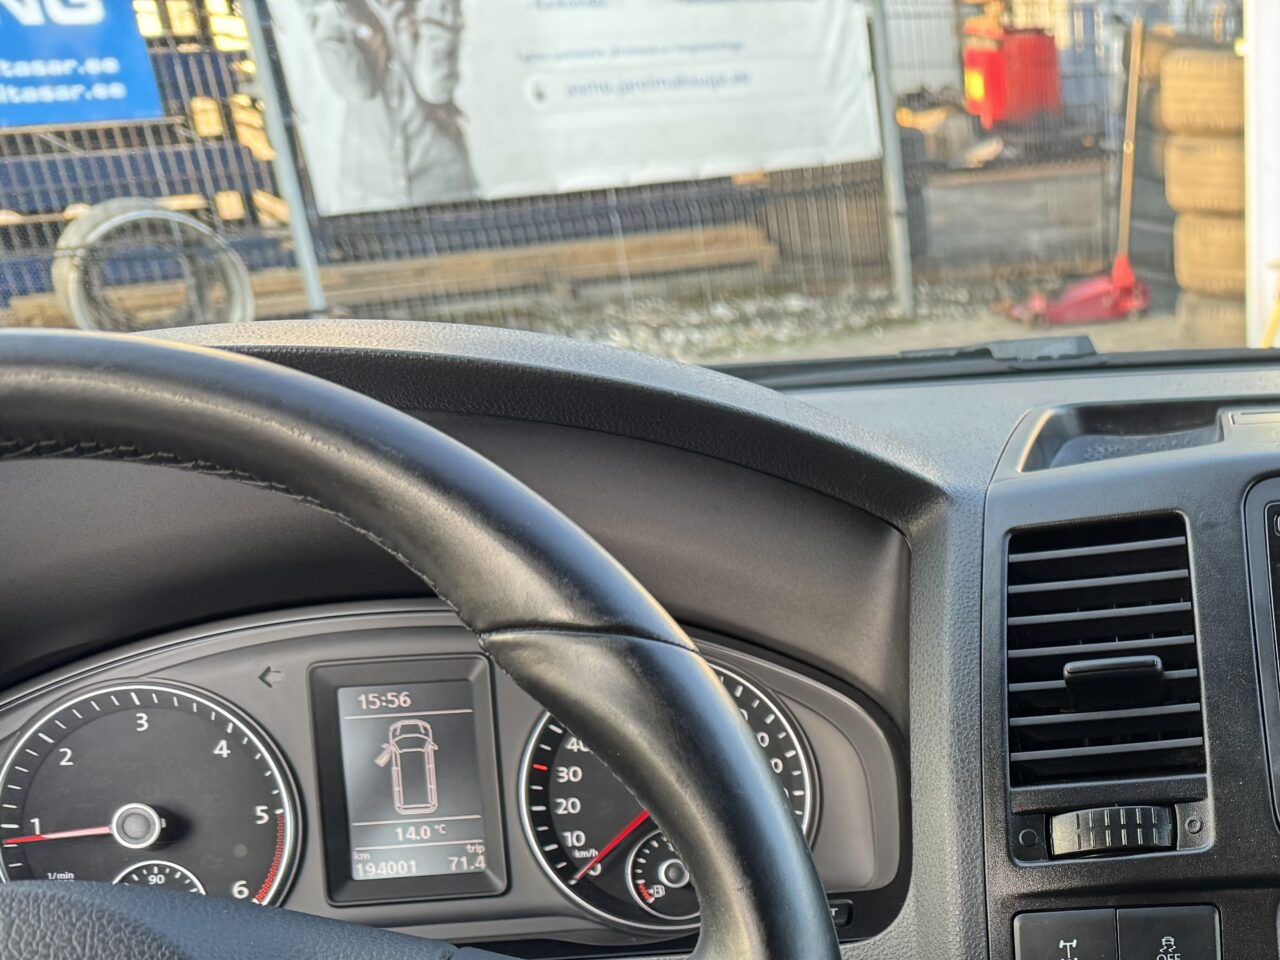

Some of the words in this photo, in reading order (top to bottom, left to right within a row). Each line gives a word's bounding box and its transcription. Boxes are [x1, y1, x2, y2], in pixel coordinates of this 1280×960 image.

[357, 691, 412, 710] 15:56
[135, 713, 149, 731] 3
[59, 748, 74, 766] 2
[213, 740, 231, 758] 4
[556, 766, 583, 783] 30
[555, 798, 581, 815] 20
[255, 806, 269, 825] 5
[30, 818, 40, 835] 1
[395, 825, 431, 841] 14.0
[562, 830, 586, 847] 10
[466, 844, 486, 855] trip
[574, 848, 599, 858] km/h
[47, 871, 75, 880] 1/min
[355, 860, 418, 878] 194001
[448, 856, 487, 872] 71.4
[148, 874, 165, 885] 90
[232, 881, 249, 899] 6
